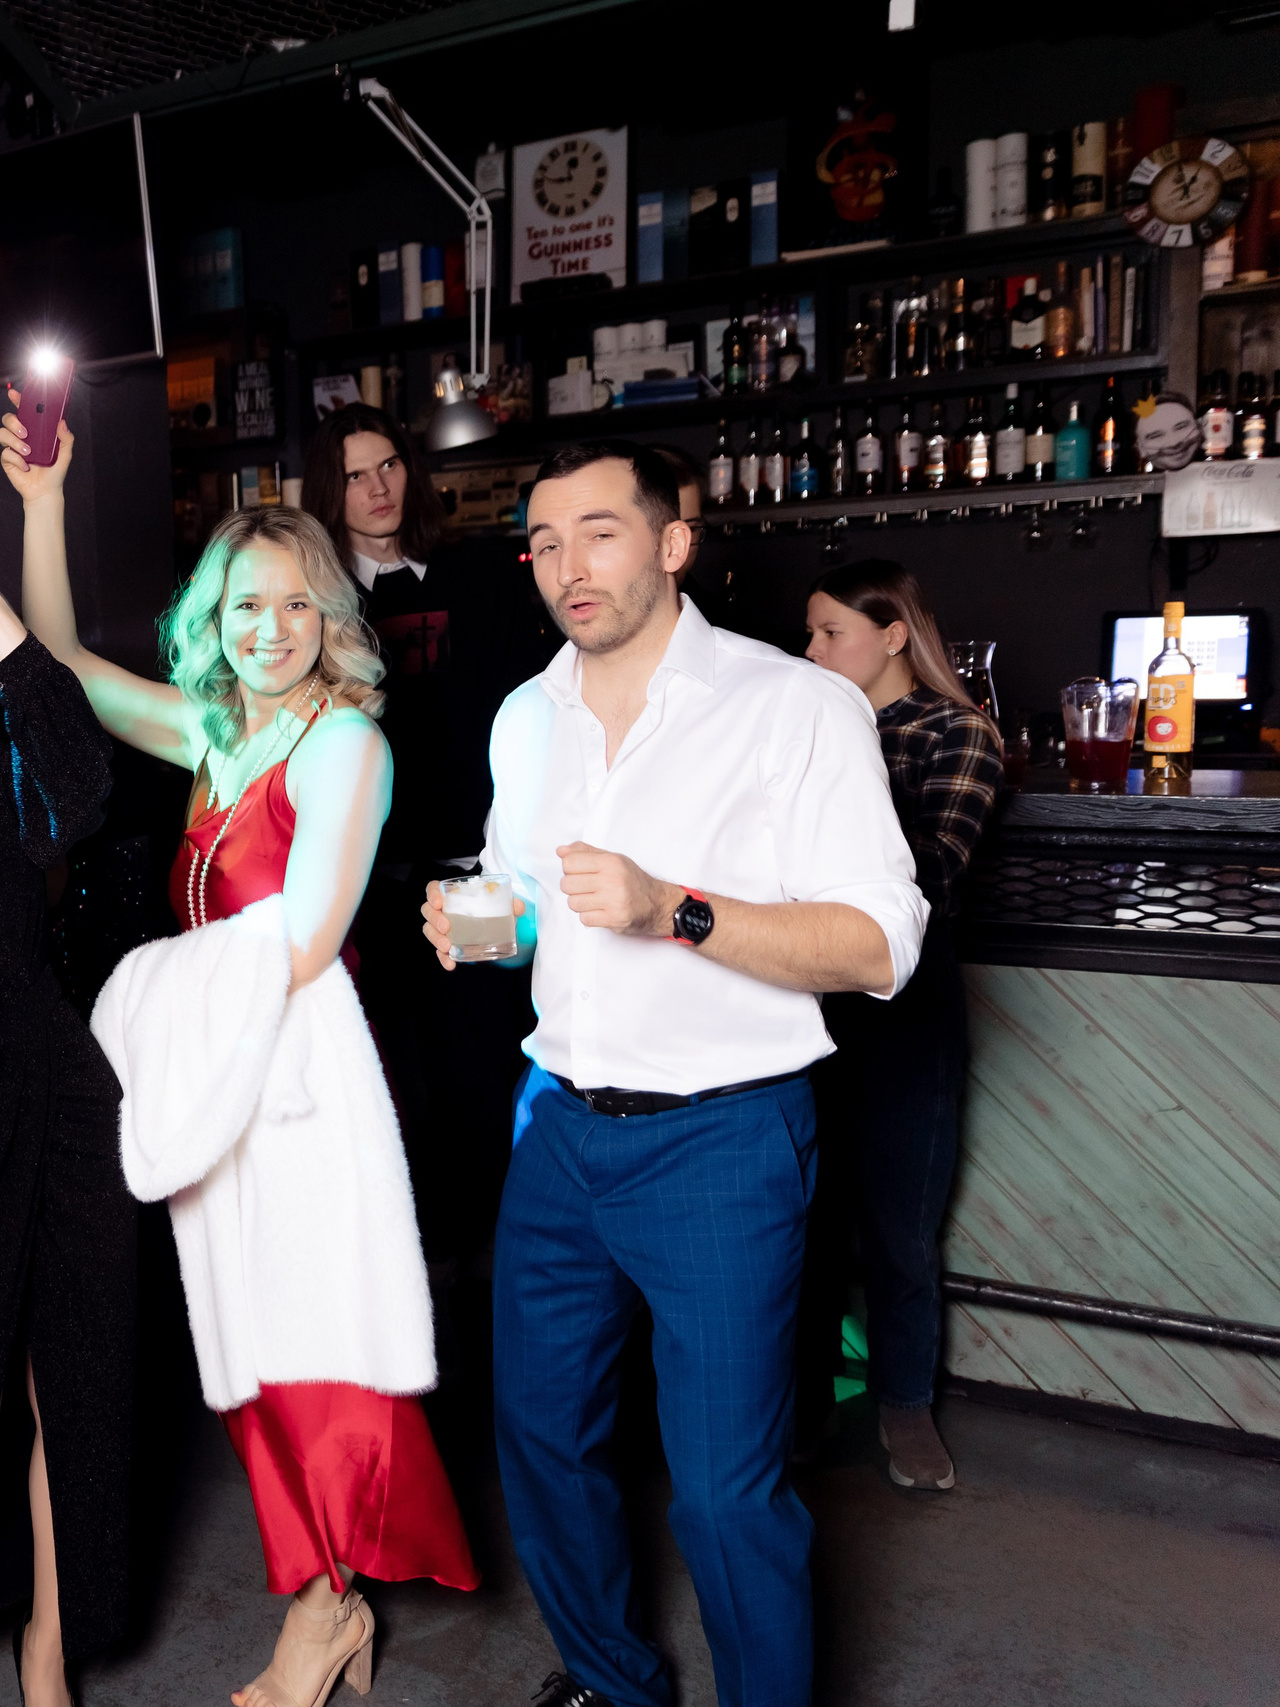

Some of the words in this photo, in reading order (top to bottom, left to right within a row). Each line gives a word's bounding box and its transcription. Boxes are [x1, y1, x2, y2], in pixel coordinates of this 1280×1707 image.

[527, 226, 548, 240] Ten
[552, 224, 565, 236] to
[569, 221, 592, 233] one
[598, 214, 614, 228] it's
[1170, 228, 1184, 246] 7
[528, 233, 613, 259] GUINNESS
[551, 257, 589, 276] TIME
